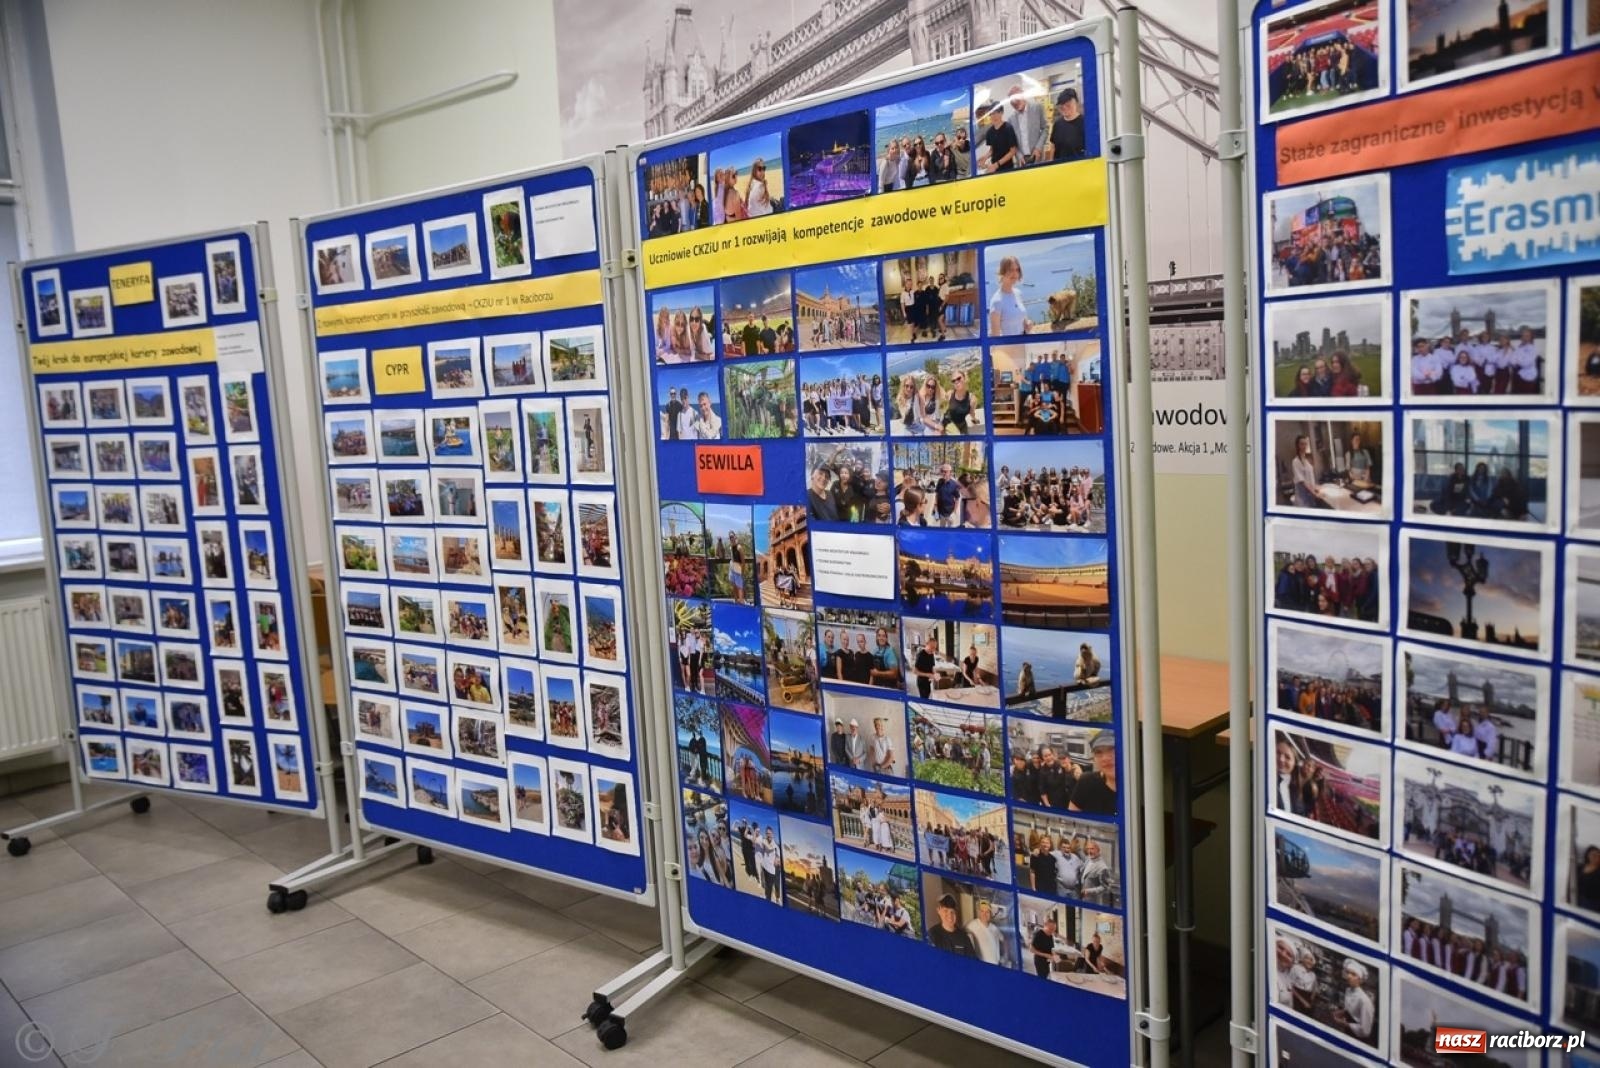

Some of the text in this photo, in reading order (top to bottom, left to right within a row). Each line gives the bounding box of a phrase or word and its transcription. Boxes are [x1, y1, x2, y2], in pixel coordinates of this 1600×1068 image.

[1279, 89, 1584, 165] Staże zagraniczne inwestycją
[649, 194, 1006, 265] Uczniowie CKZiU nr 1 rozwijają kompetencje zawodowe w Europie
[1465, 192, 1600, 236] Erasm
[385, 363, 410, 376] CYPR
[699, 453, 754, 471] SEWILLA
[1178, 441, 1201, 456] Akcja
[1203, 441, 1208, 453] 1
